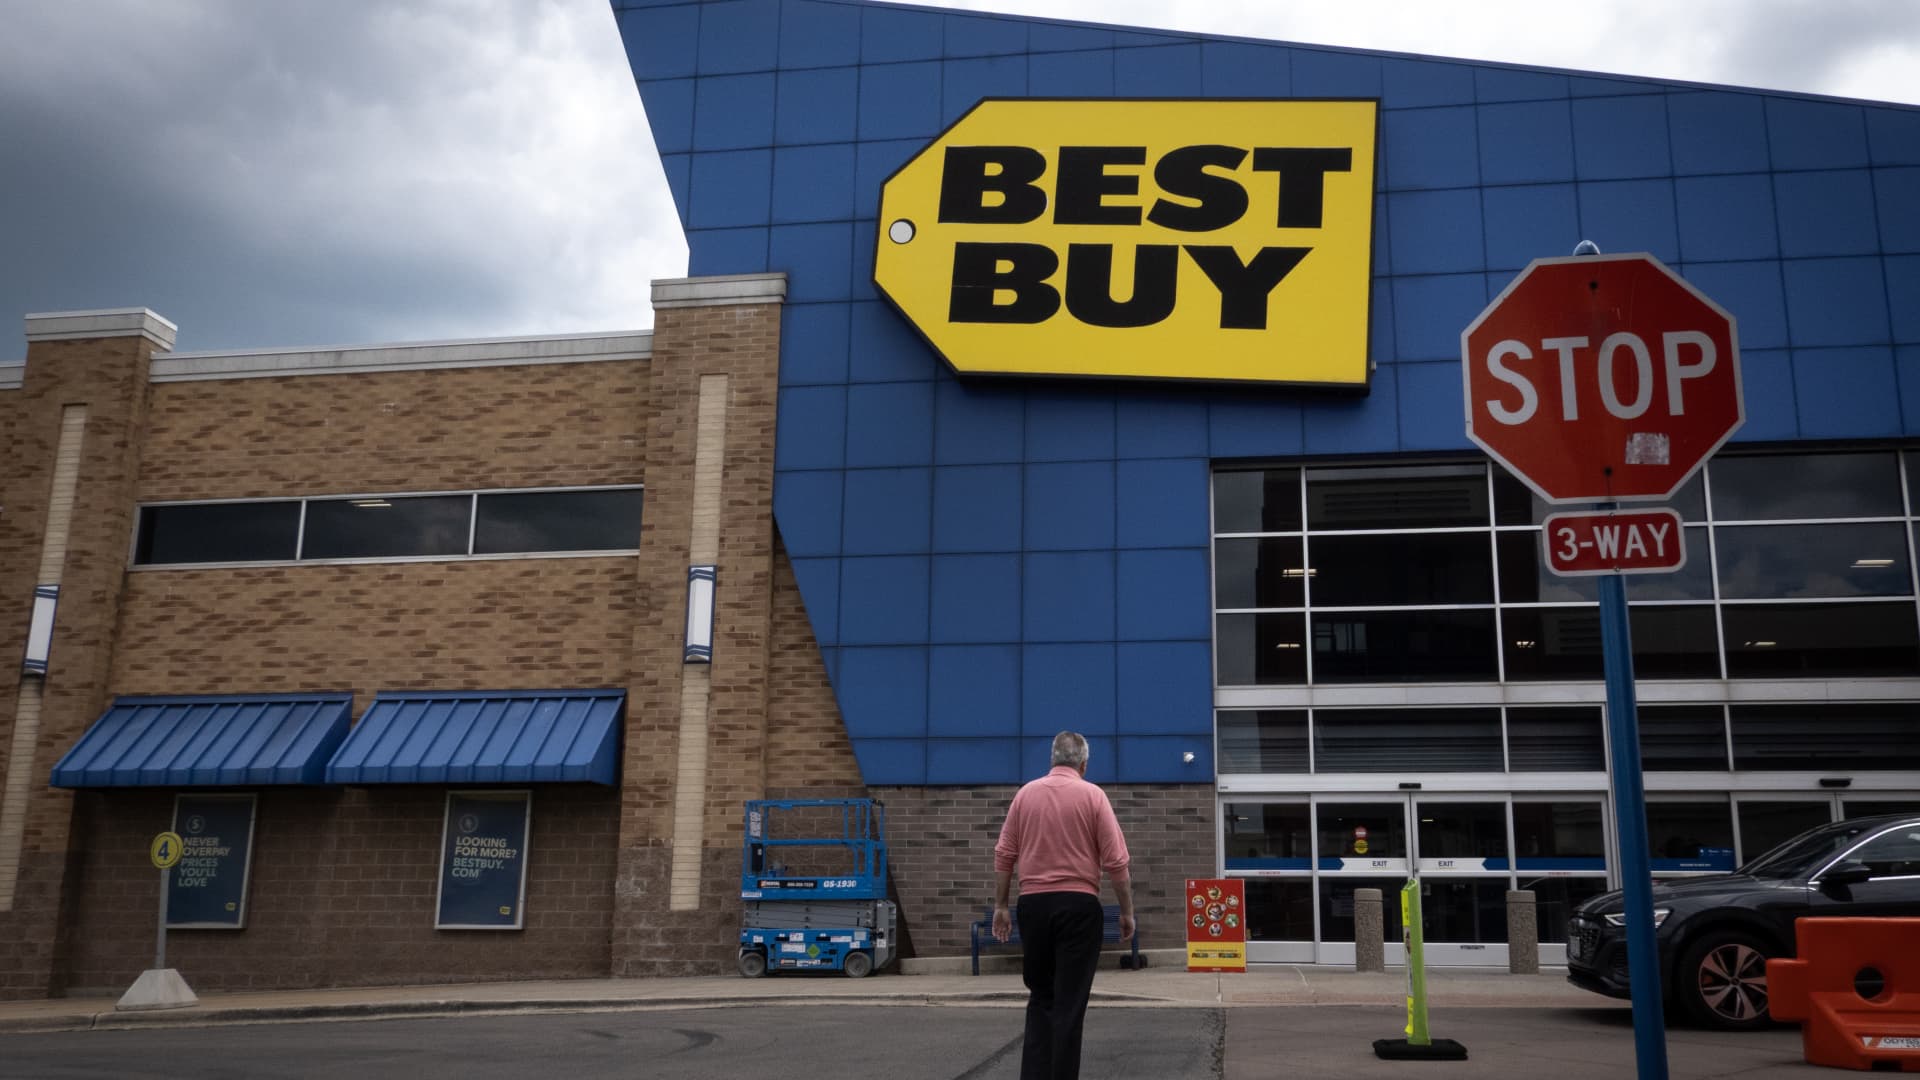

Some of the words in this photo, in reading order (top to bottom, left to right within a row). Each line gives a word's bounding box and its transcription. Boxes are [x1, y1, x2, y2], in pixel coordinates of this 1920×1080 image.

[937, 144, 1353, 232] BEST
[948, 241, 1315, 330] BUY
[1486, 330, 1717, 425] STOP
[1556, 522, 1669, 561] 3-WAY
[183, 837, 219, 846] NEVER
[456, 836, 507, 848] LOOKING
[157, 837, 170, 860] 4
[182, 847, 231, 857] OVERPAY
[455, 846, 478, 857] FOR
[479, 847, 517, 859] MORE?
[180, 857, 218, 867] PRICES
[180, 868, 217, 877] YOU'LL
[178, 877, 208, 887] LOVE
[823, 880, 857, 888] GS-1930
